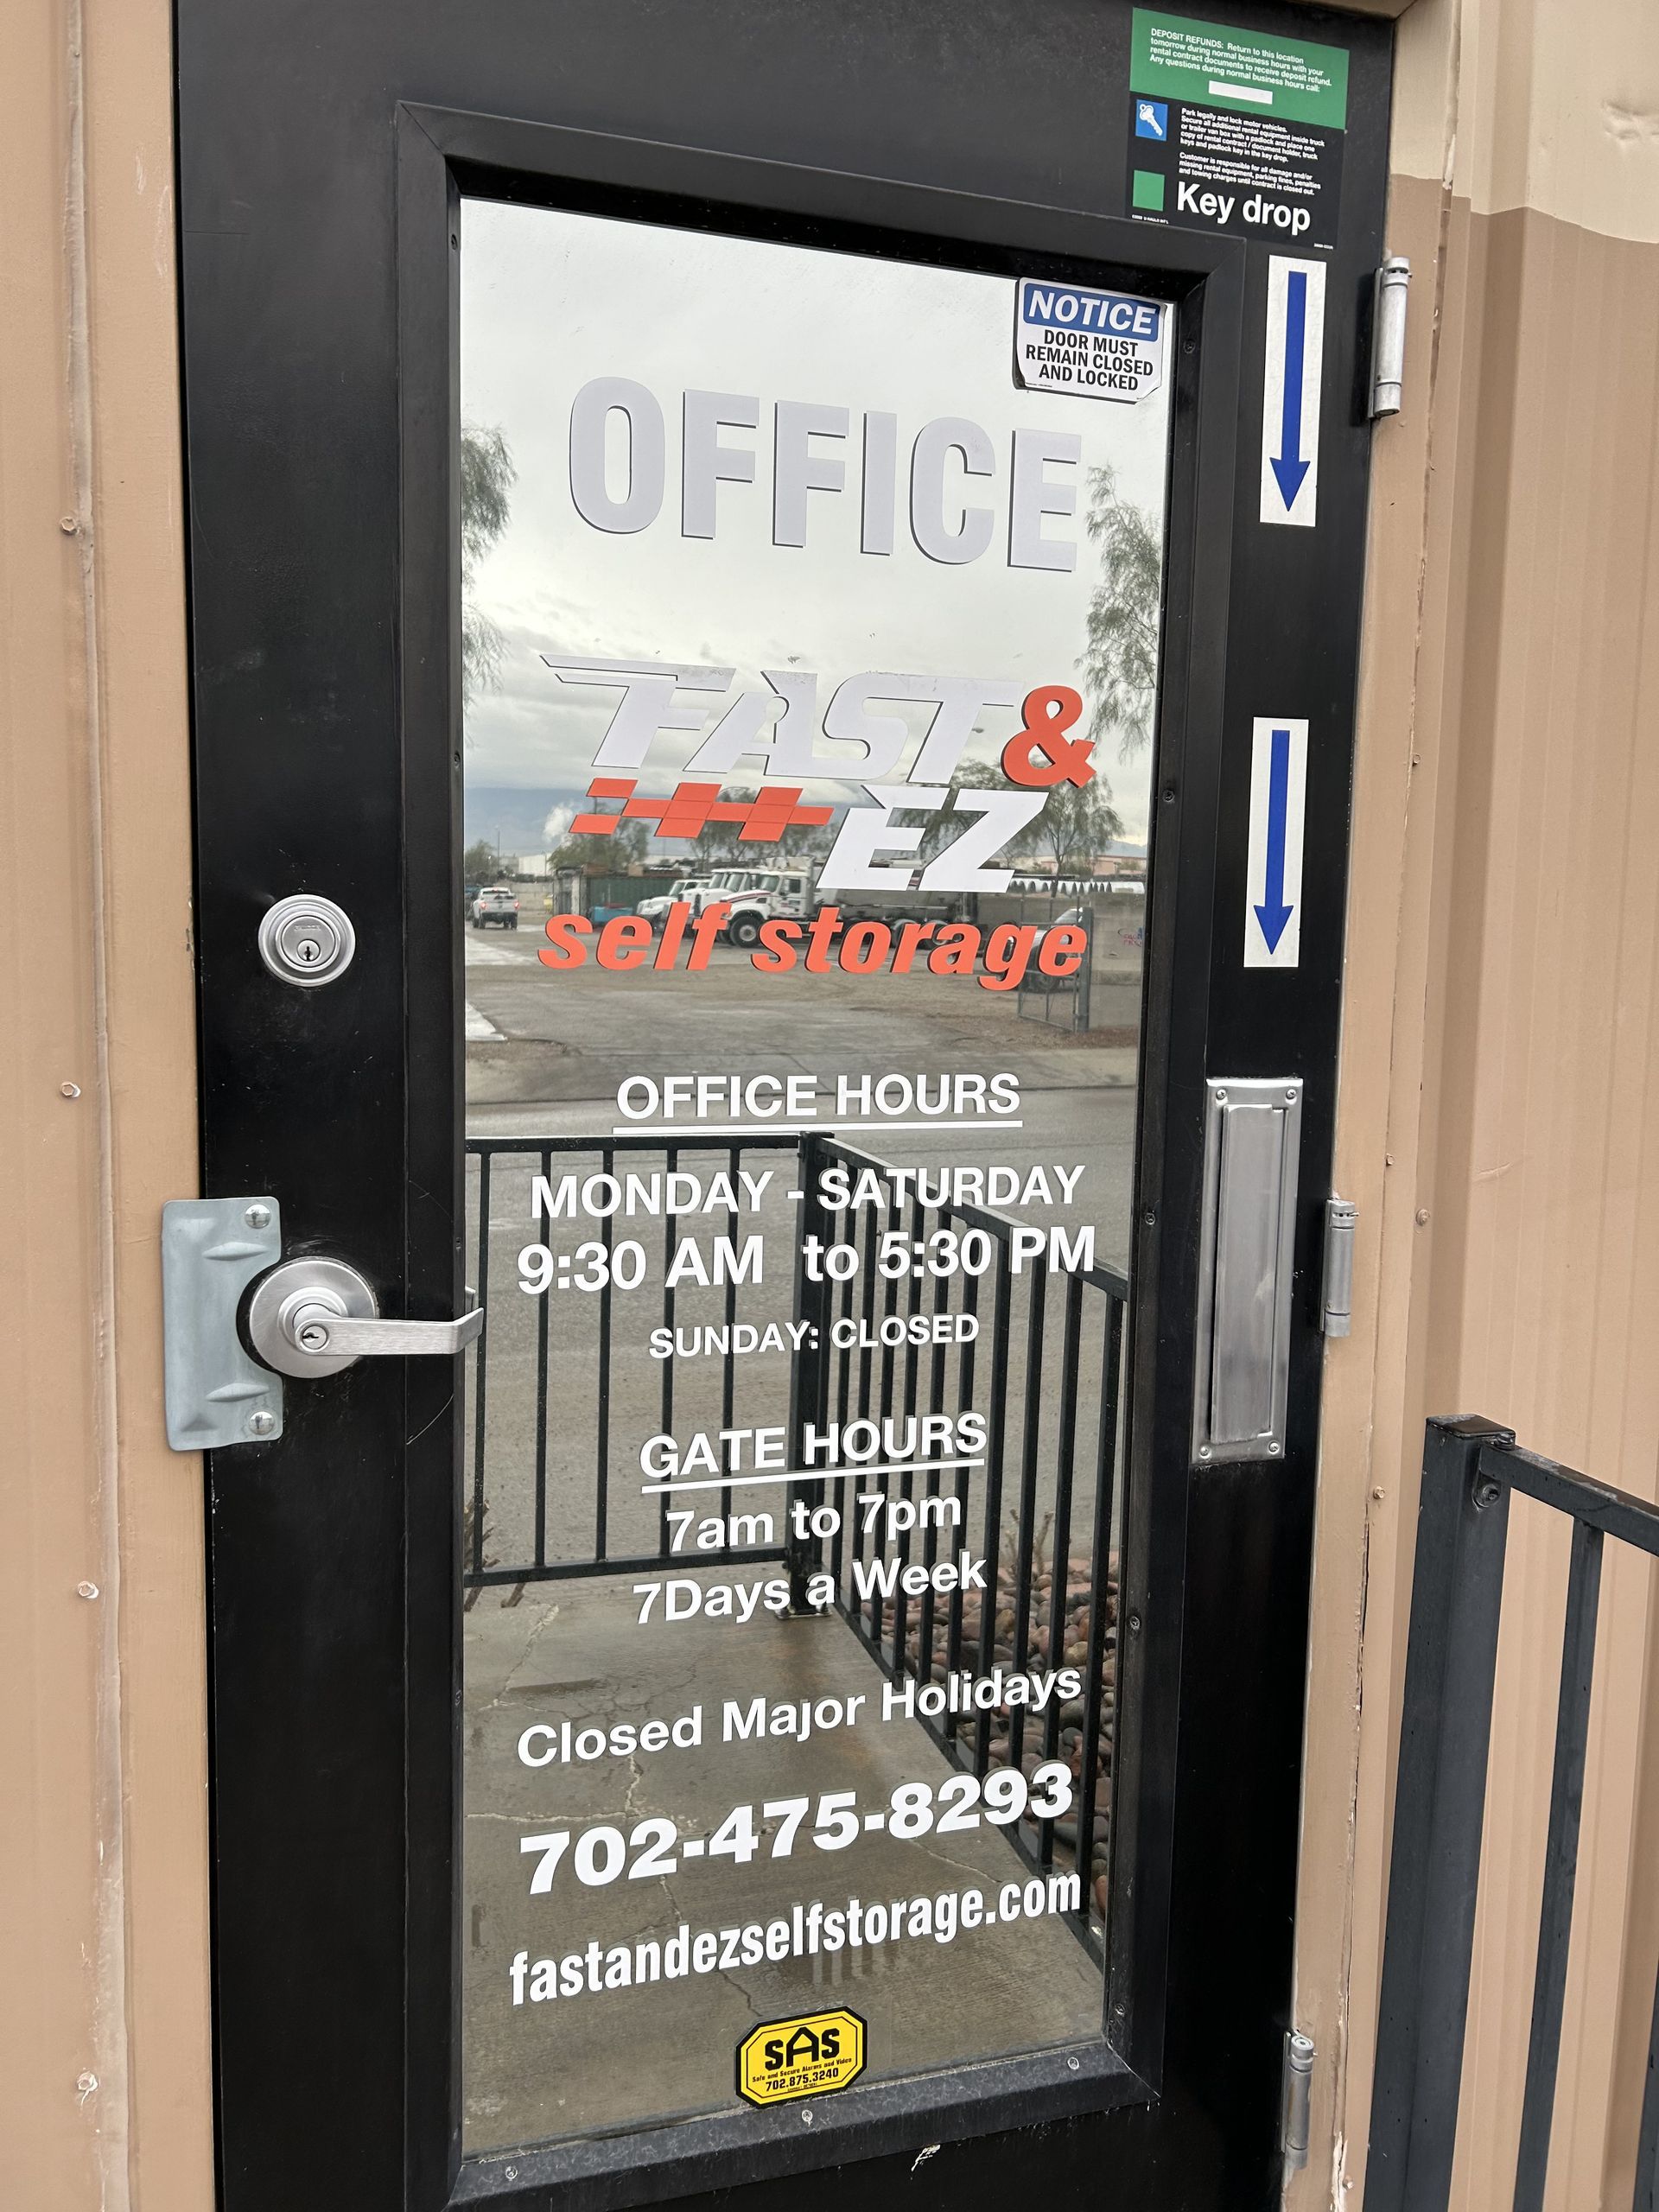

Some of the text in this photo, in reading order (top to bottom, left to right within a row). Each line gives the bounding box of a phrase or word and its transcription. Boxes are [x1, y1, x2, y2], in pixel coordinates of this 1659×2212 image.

[1150, 47, 1171, 56] rental
[1173, 51, 1203, 62] contract
[1205, 55, 1243, 69] documents
[1255, 66, 1280, 76] receive
[1281, 71, 1306, 81] deposit
[1308, 76, 1332, 86] refund.
[1151, 28, 1184, 41] DEPOSIT
[1186, 35, 1224, 48] REFUNDS:
[1228, 43, 1251, 54] Return
[1262, 49, 1274, 58] this
[1276, 52, 1304, 64] location
[1151, 37, 1185, 50] tomorrow
[1188, 44, 1210, 56] during
[1212, 50, 1236, 60] normal
[1238, 54, 1269, 66] business
[1271, 60, 1291, 69] hours
[1293, 64, 1306, 73] with
[1150, 54, 1164, 65] Any
[1166, 59, 1200, 70] questions
[1202, 65, 1224, 76] during
[1226, 69, 1251, 79] normal
[1253, 73, 1283, 86] business
[1285, 79, 1304, 89] hours
[1182, 107, 1196, 117] Park
[1197, 111, 1217, 121] legally
[1230, 116, 1243, 124] lock
[1262, 124, 1287, 132] vehicles.
[1177, 181, 1311, 235] Key drop
[1028, 289, 1156, 334] NOTICE
[1026, 344, 1153, 376] REMAIN CLOSED
[1044, 329, 1139, 357] DOOR MUST
[1039, 364, 1139, 391] AND LOCKED
[569, 376, 1083, 572] OFFICE
[539, 654, 1097, 788] FAST &
[817, 784, 1050, 893] EZ
[536, 901, 1088, 992] self storage
[616, 1071, 1021, 1120] OFFICE HOURS
[531, 1164, 1086, 1220] MONDAY - SATURDAY
[517, 1225, 1096, 1295] 9:30 AM to 5:30 PM
[648, 1313, 980, 1360] SUNDAY: CLOSED
[639, 1413, 988, 1480] GATE HOURS
[667, 1491, 962, 1554] 7am to 7pm
[632, 1550, 987, 1625] 7Days a Week
[518, 1664, 1083, 1769] Closed Major Holidays
[518, 1761, 1074, 1896] 702-475-8293
[509, 1871, 1081, 2006] fastandezselfstorage.com
[765, 2026, 840, 2071] SAS
[780, 2069, 799, 2077] Secure
[802, 2064, 822, 2073] Alarms
[766, 2068, 838, 2091] 702.875.3240
